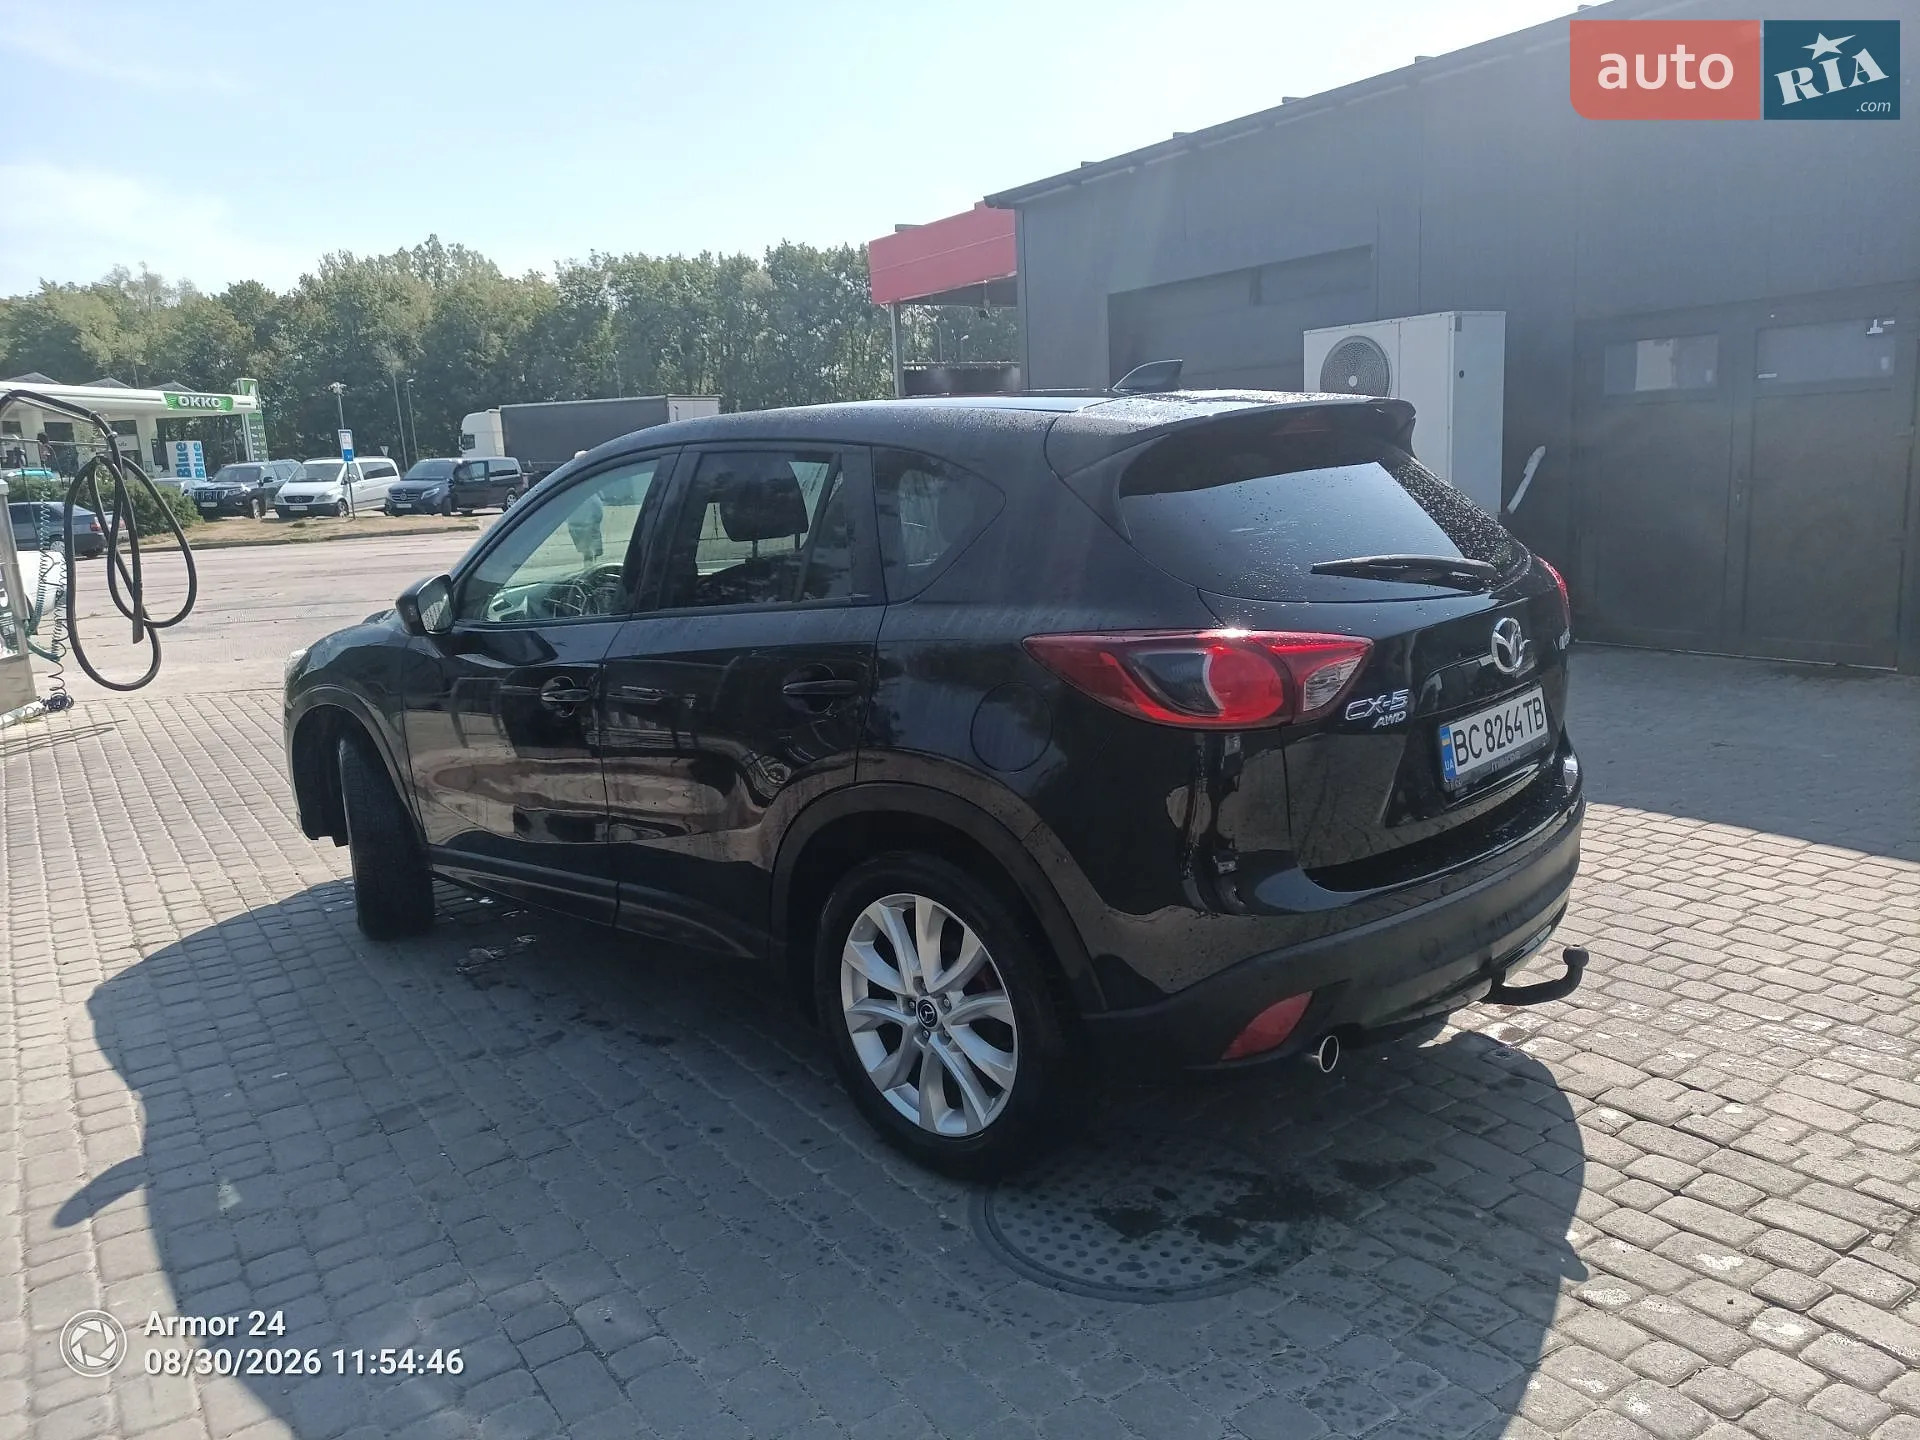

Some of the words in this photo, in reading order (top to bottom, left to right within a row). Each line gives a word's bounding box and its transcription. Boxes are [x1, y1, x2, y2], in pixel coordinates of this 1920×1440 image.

[177, 396, 222, 408] OKKO
[176, 442, 192, 478] Blue
[1345, 688, 1410, 721] CX-5
[1373, 710, 1407, 729] AWD
[1444, 759, 1455, 771] UA
